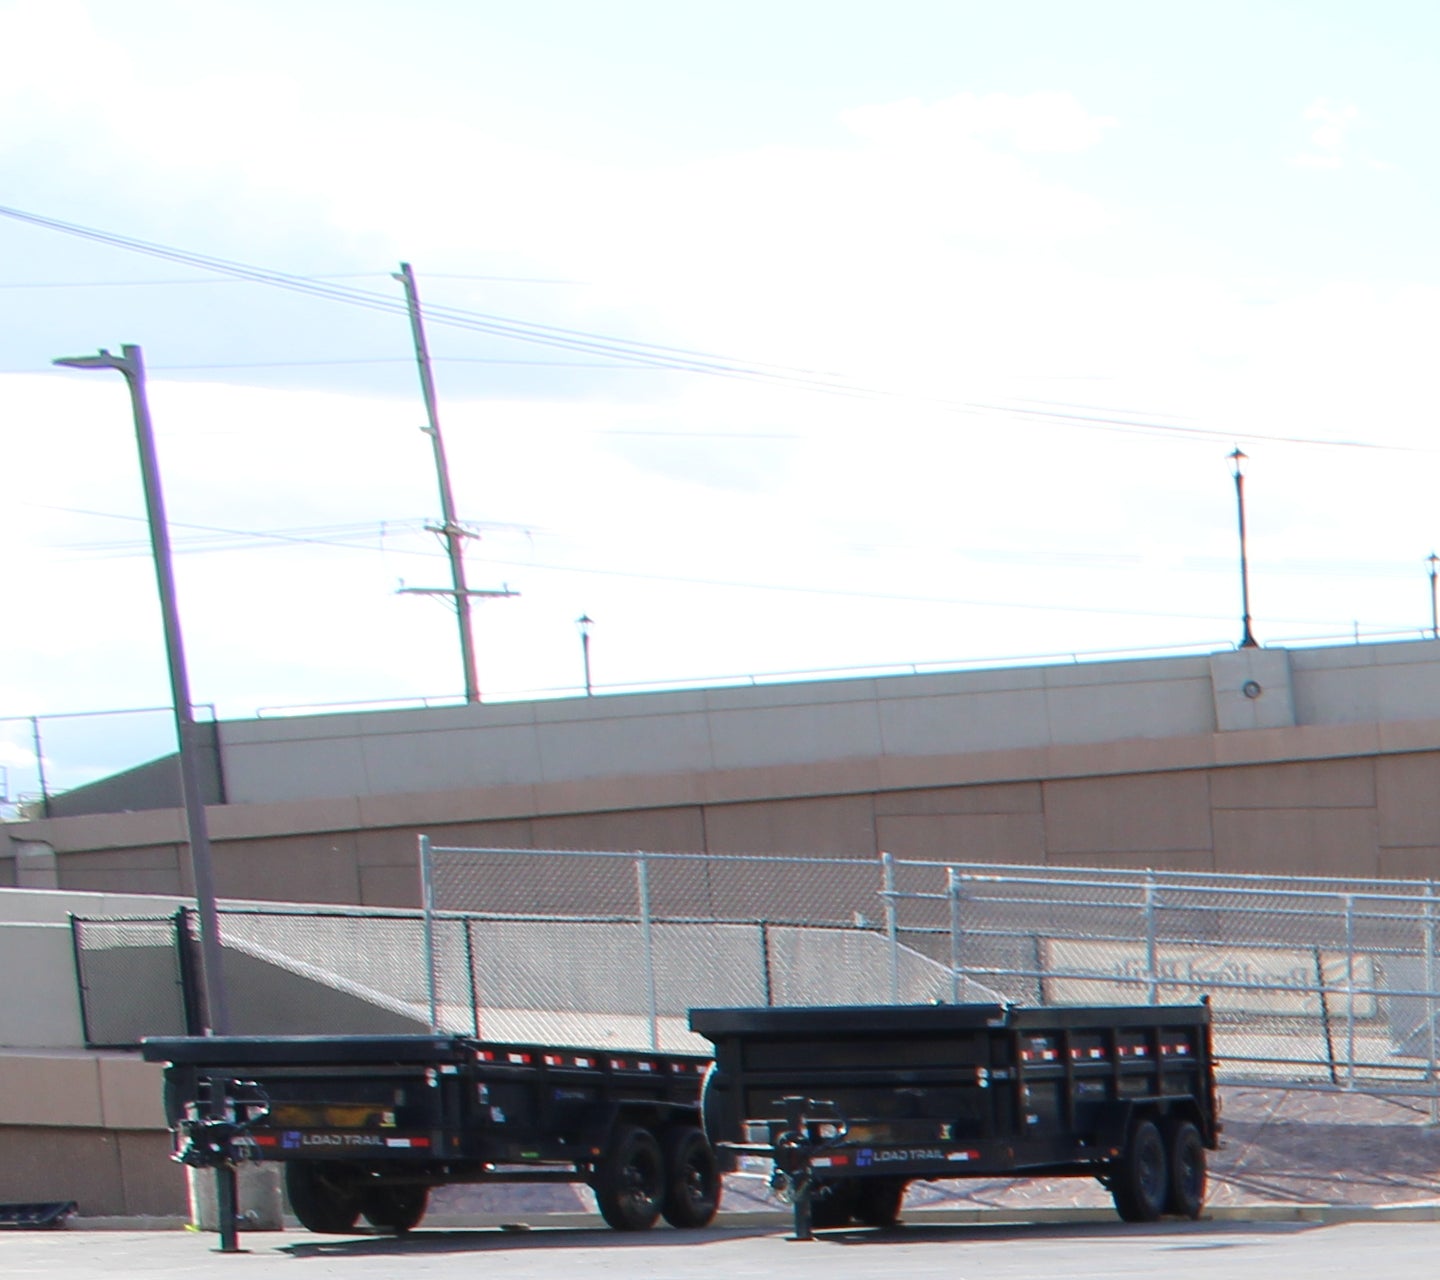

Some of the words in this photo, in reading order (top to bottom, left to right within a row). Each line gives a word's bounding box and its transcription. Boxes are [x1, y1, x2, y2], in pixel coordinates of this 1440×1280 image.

[303, 1135, 343, 1146] LOAD
[344, 1135, 383, 1146] TRAIL
[873, 1150, 908, 1162] LOAD
[909, 1150, 944, 1161] TRAIL
